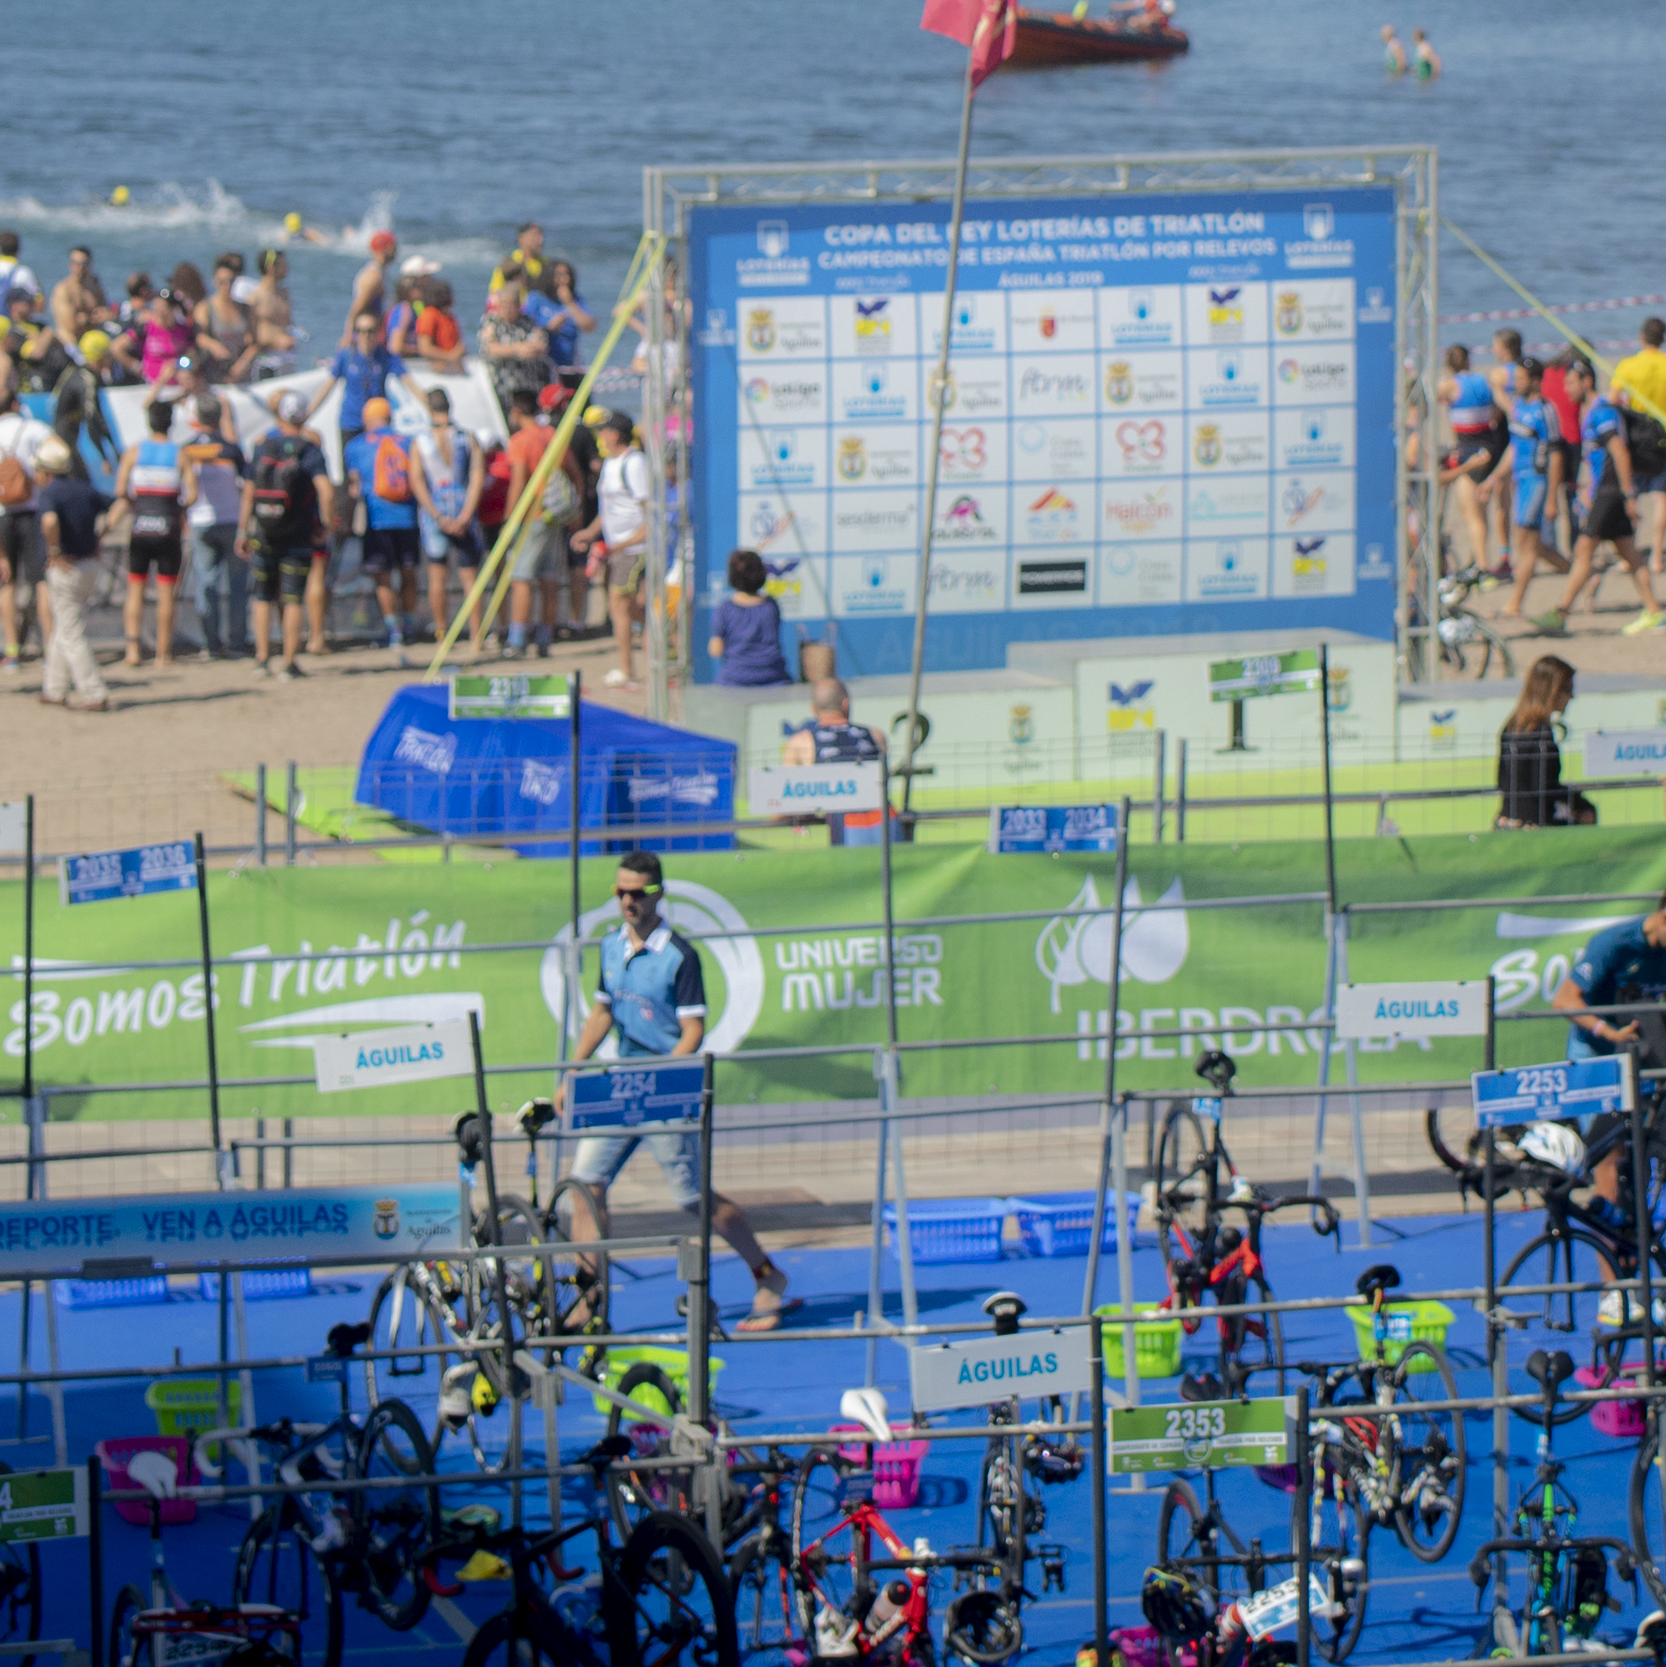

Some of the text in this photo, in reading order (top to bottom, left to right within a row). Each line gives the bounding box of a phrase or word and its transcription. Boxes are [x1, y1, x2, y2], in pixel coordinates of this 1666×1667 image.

[824, 223, 894, 245] COPA
[896, 222, 945, 244] DEL
[997, 213, 1109, 240] LOTERÍAS
[1114, 215, 1147, 237] DE
[1150, 209, 1265, 235] TRIATLÓN
[818, 249, 949, 270] CAMPEONATO
[981, 242, 1056, 265] ESPAÑA
[1058, 238, 1149, 262] TRIATLÓN
[1152, 240, 1193, 260] POR
[1195, 237, 1276, 258] RELEVOS
[782, 779, 857, 798] ÁGUILAS
[232, 910, 465, 1008] Triatlón
[782, 968, 944, 1012] MUJER
[1375, 997, 1460, 1020] ÁGUILAS
[1077, 1004, 1432, 1061] IBERDRO
[355, 1040, 444, 1069] ÁGUILAS
[610, 1072, 656, 1099] 2254
[1517, 1068, 1568, 1095] 2253
[142, 1210, 195, 1232] VEN
[204, 1209, 223, 1228] A
[229, 1203, 348, 1227] ÁGUILAS
[956, 1351, 1059, 1386] ÁGUILAS
[1165, 1408, 1226, 1437] 2353
